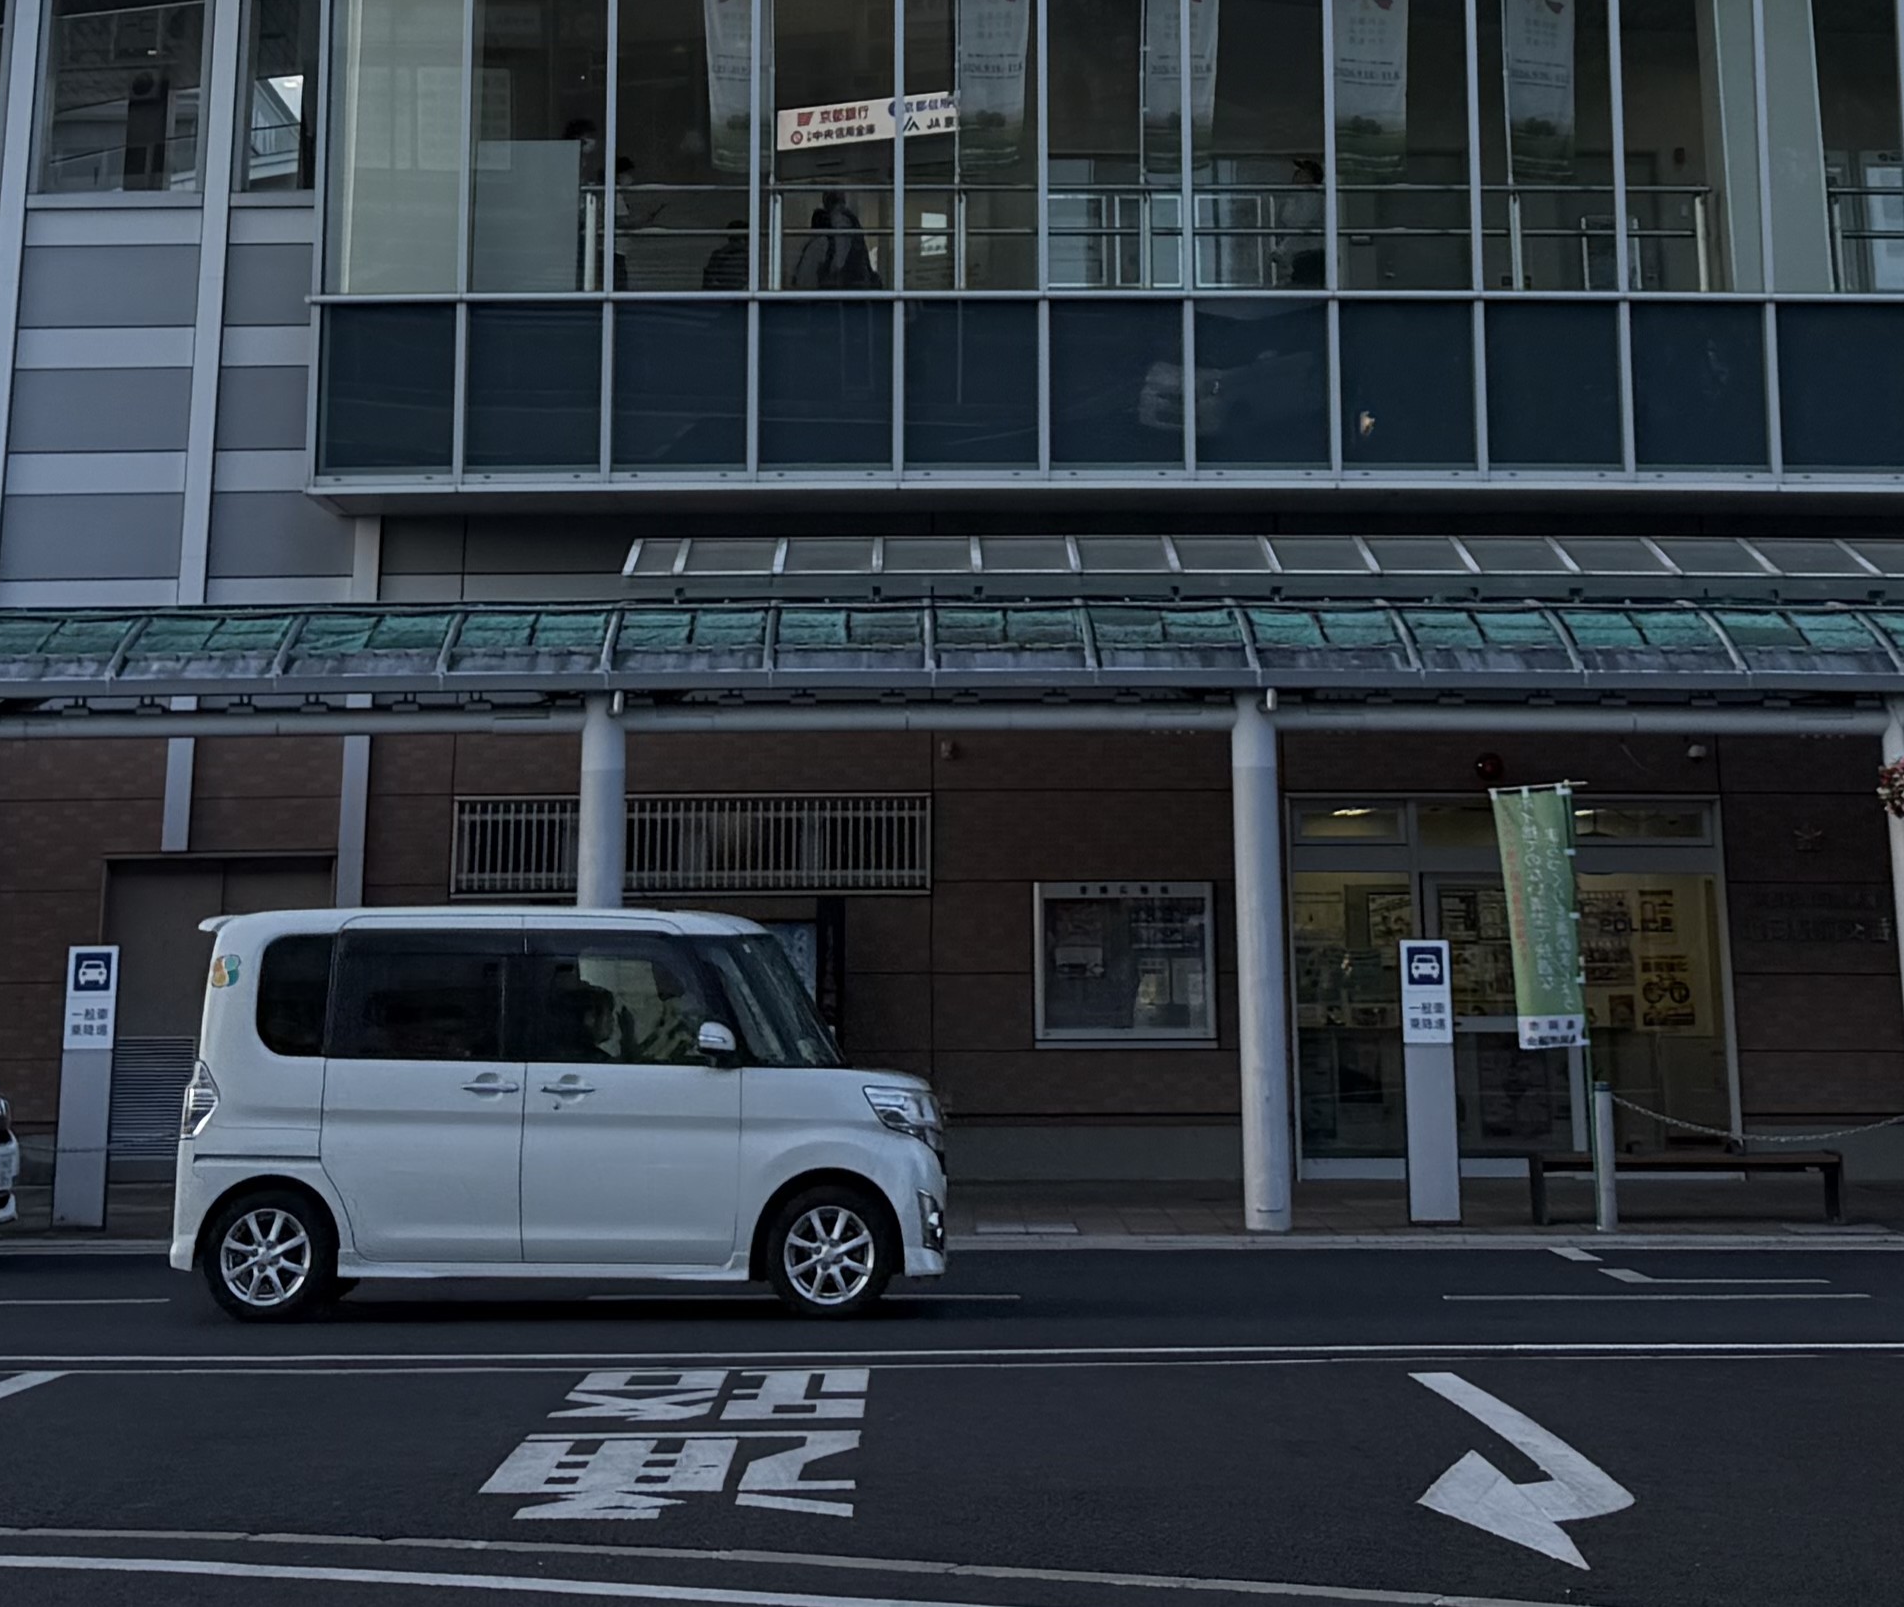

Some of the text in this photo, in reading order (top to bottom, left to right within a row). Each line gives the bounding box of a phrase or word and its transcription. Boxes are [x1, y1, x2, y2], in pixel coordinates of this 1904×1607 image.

[819, 105, 869, 124] 京都銀行
[927, 117, 941, 129] JA
[1599, 918, 1674, 933] POLICE
[478, 1368, 870, 1521] 通路
